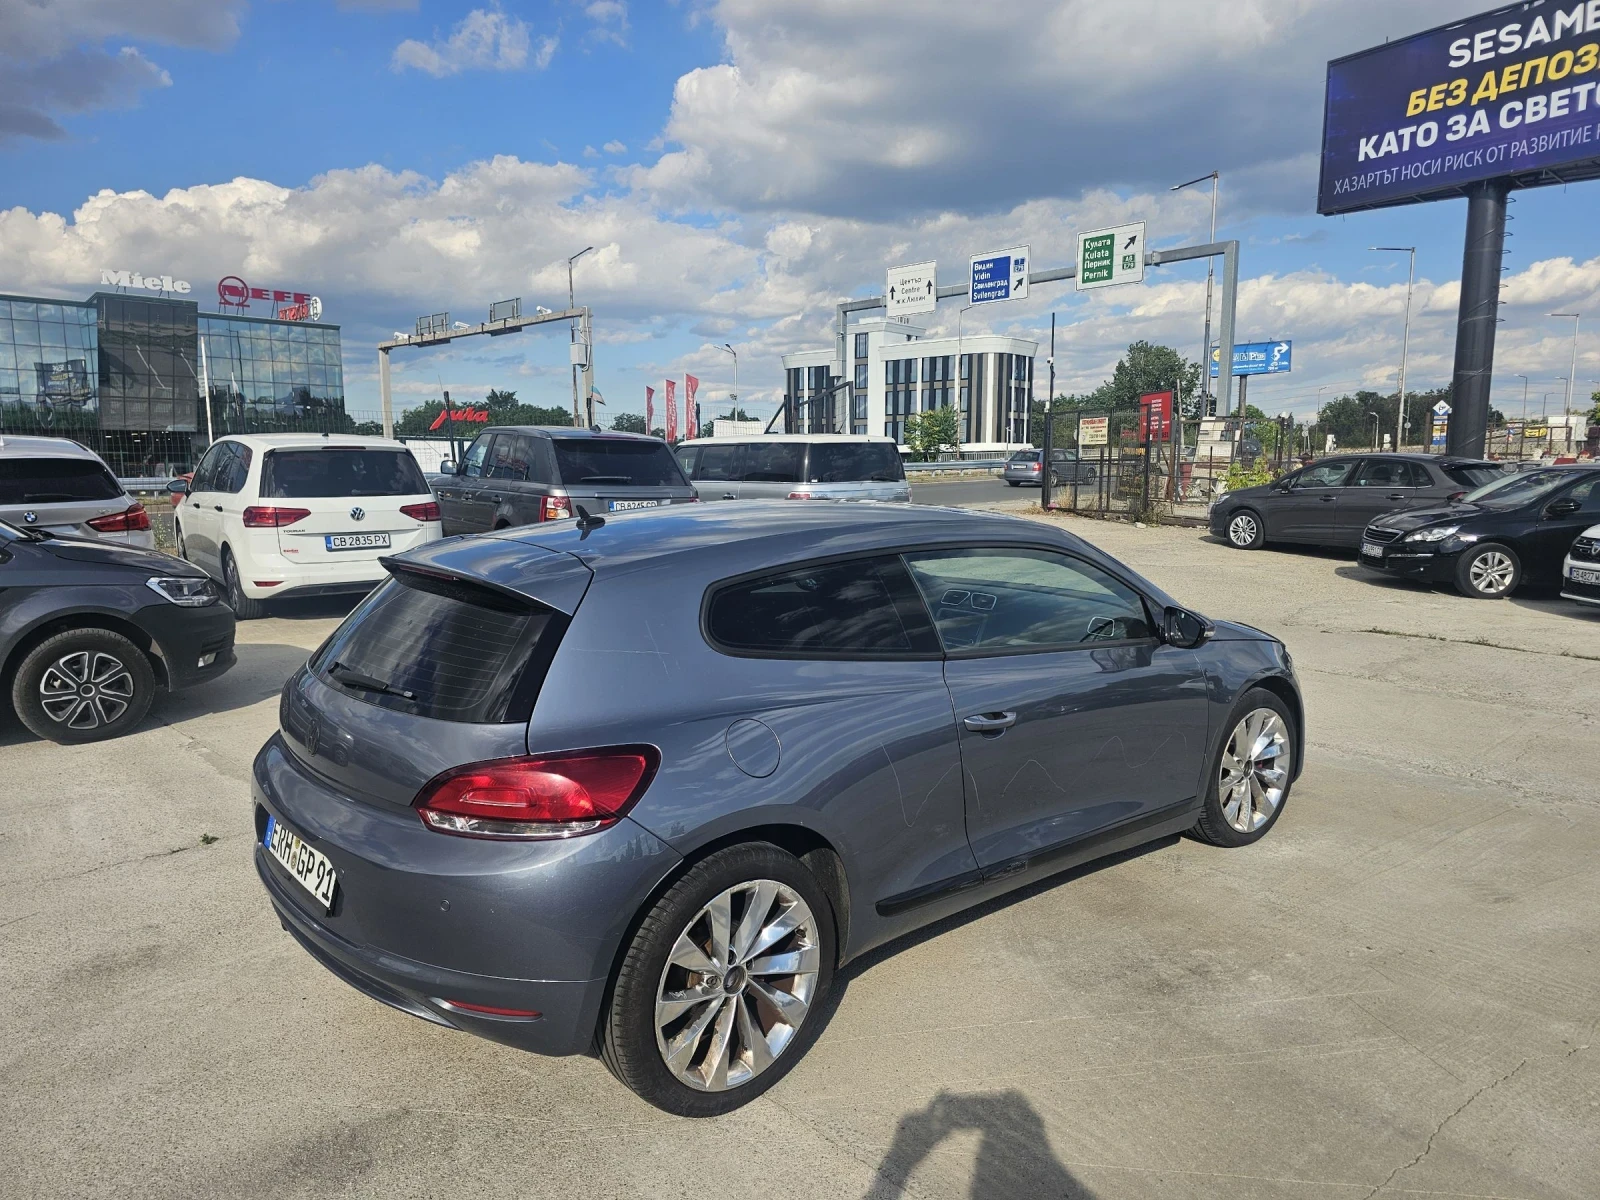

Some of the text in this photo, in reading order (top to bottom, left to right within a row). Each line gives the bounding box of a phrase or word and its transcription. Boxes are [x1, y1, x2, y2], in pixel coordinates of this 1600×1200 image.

[1406, 43, 1600, 118] БЕЗ ДЕПОЗ
[1357, 81, 1600, 162] КАТО ЗА СВЕТ
[1333, 167, 1399, 195] ХАЗАРТЪТ
[1401, 156, 1441, 181] НОСИ
[1444, 149, 1483, 173] РИСК
[1486, 144, 1508, 165] ОТ
[1509, 124, 1592, 159] РАЗВИТИЕ
[1085, 238, 1111, 250] Кулата
[1085, 249, 1109, 260] Kulata
[974, 263, 994, 271] Видин
[1084, 259, 1111, 269] Перник
[100, 268, 192, 293] Miele
[974, 271, 991, 280] Vidin
[1084, 269, 1109, 280] Pernik
[973, 280, 1009, 290] Свиленград
[219, 281, 310, 305] NEFF
[973, 288, 1006, 300] Svilengrad
[333, 534, 388, 547] CB 2835 PX
[271, 822, 334, 902] ERH GP 91
